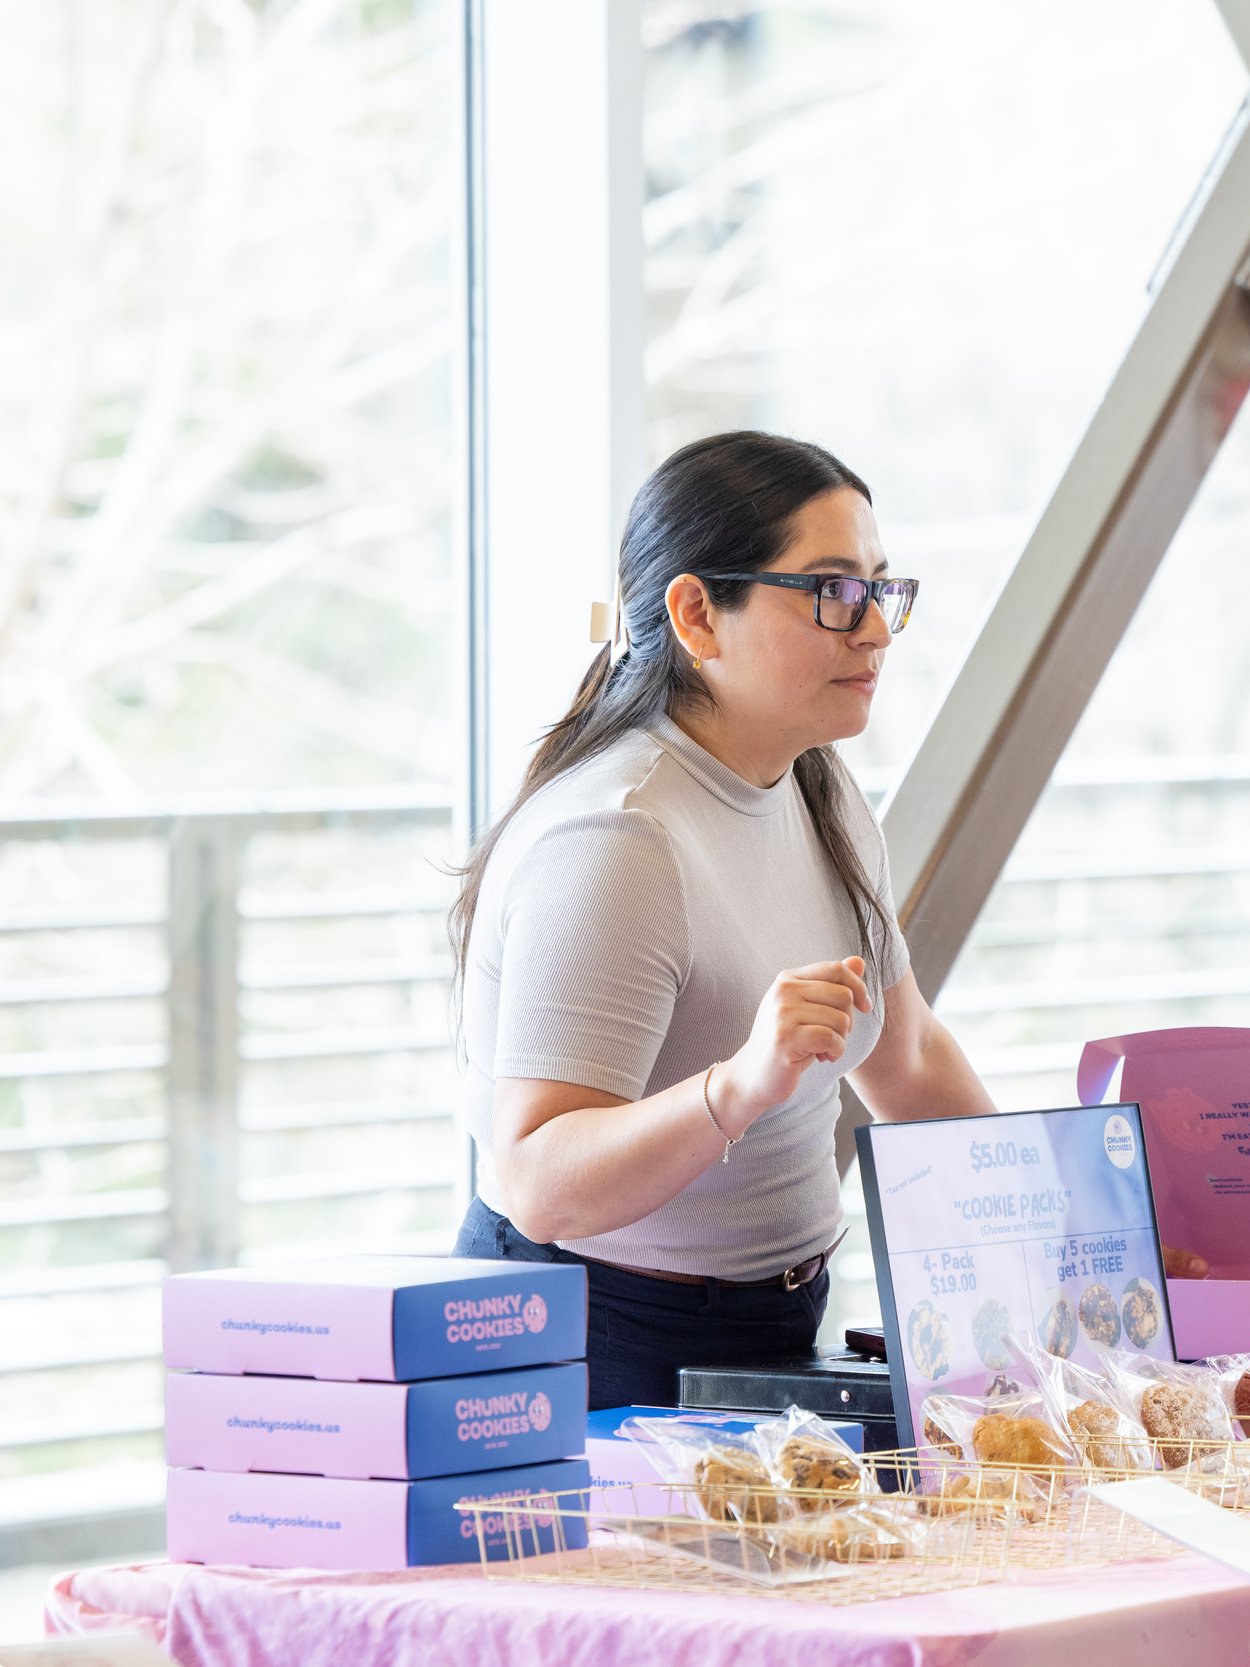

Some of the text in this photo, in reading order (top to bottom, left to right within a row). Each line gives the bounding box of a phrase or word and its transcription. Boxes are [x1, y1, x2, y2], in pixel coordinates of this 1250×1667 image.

[1106, 1136, 1131, 1144] CHUNKY
[970, 1140, 1040, 1173] $5.00 ea
[953, 1189, 1072, 1220] "COOKIE PACKS"
[980, 1219, 1056, 1237] (Choose any Flavors)
[923, 1251, 975, 1272] 4- Pack
[1044, 1236, 1128, 1262] Buy 5 cookies
[1057, 1256, 1124, 1281] get 1 FREE
[931, 1272, 976, 1297] $19.00
[444, 1293, 522, 1322] CHUNKY
[220, 1318, 330, 1335] chunkycookies.us
[446, 1317, 525, 1343] COOKIES
[455, 1392, 528, 1421] CHUNKY
[227, 1416, 340, 1433] chunkycookies.us
[457, 1415, 530, 1441] COOKIES
[228, 1512, 342, 1529] chunkycookies.us
